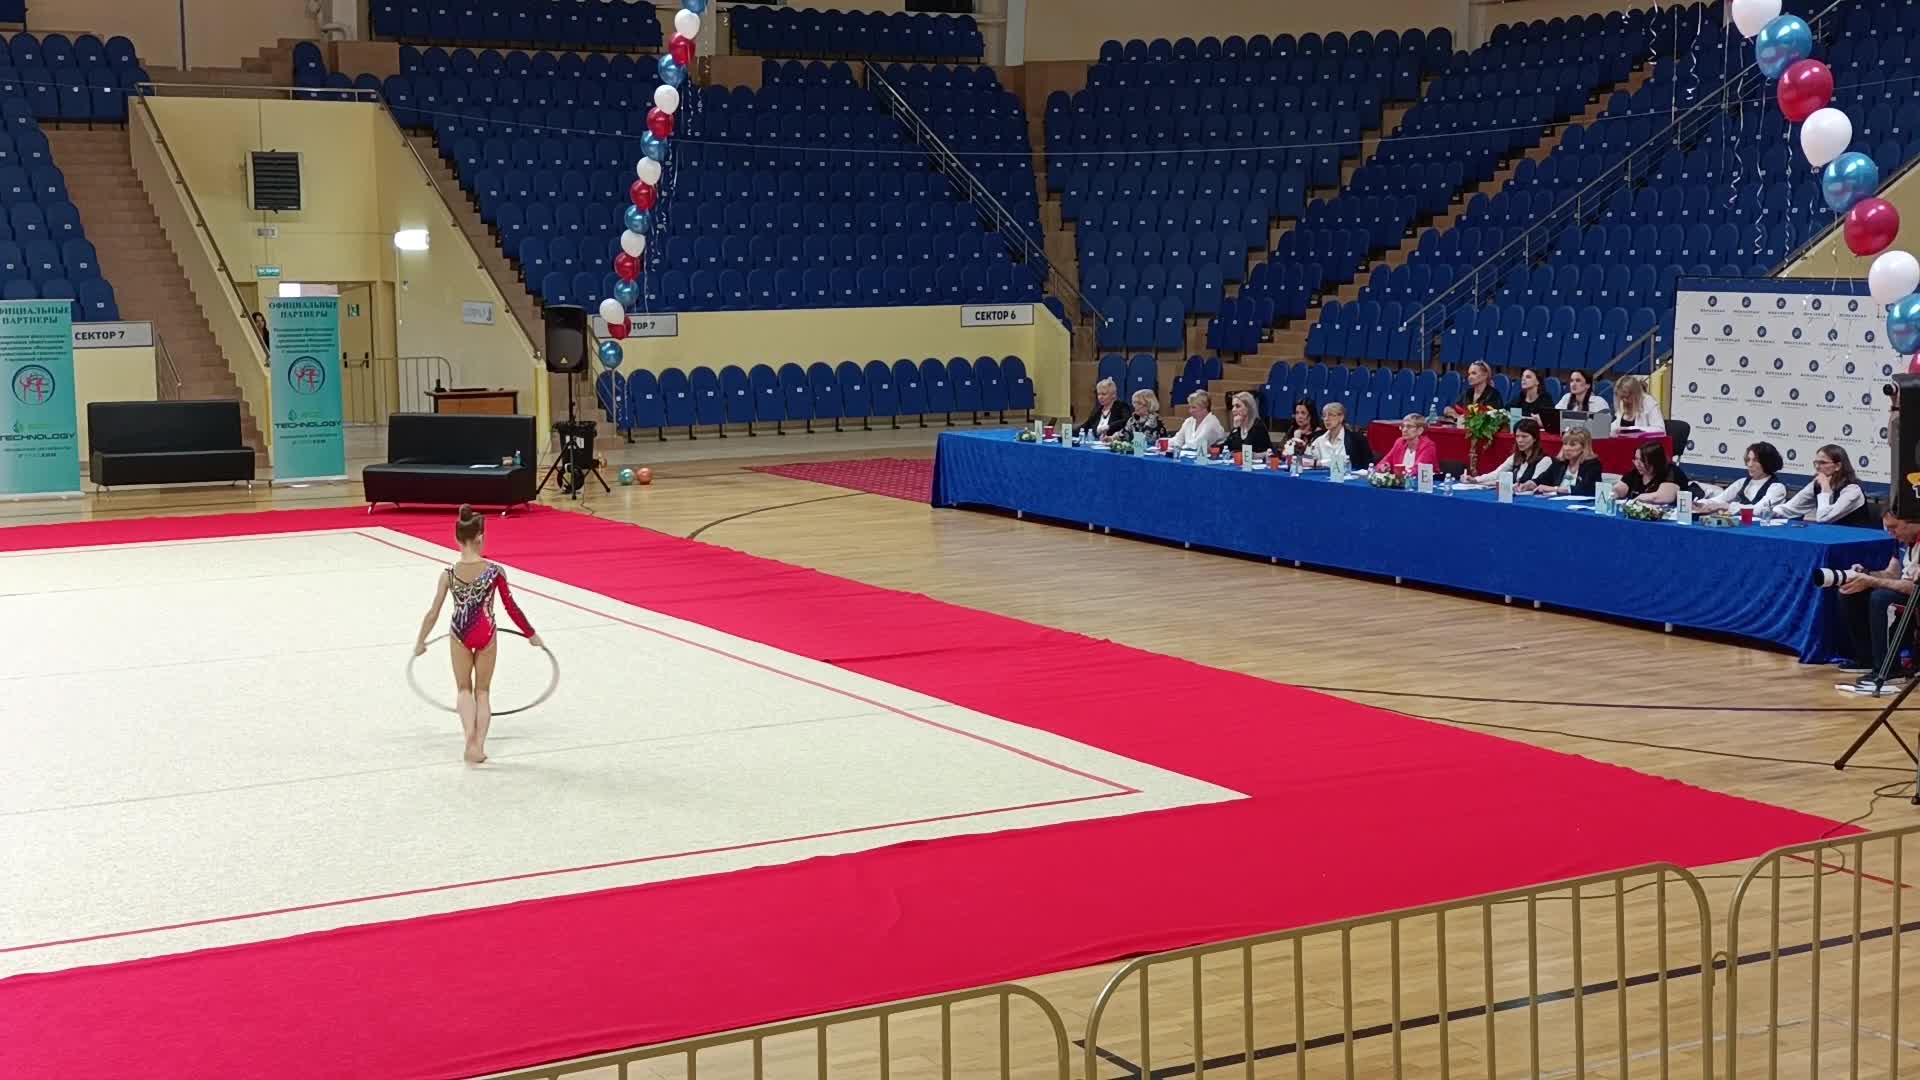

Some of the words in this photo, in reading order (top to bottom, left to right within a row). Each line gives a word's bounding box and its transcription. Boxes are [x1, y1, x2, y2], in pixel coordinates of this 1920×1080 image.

[0, 306, 69, 315] ФИЦИАЛЬНЫЕ
[280, 310, 328, 319] ПАРТНЕРЫ
[975, 310, 1009, 320] СЕКТОР
[1011, 310, 1017, 319] 6
[2, 316, 58, 325] ПАРТНЕРЫ
[632, 322, 648, 330] ТОР
[650, 321, 656, 329] 7
[74, 331, 117, 341] СЕКТОР
[118, 330, 126, 339] 7
[274, 420, 341, 429] TECHNOLOGY
[0, 432, 75, 441] TECHNOLOGY
[1421, 469, 1430, 483] E
